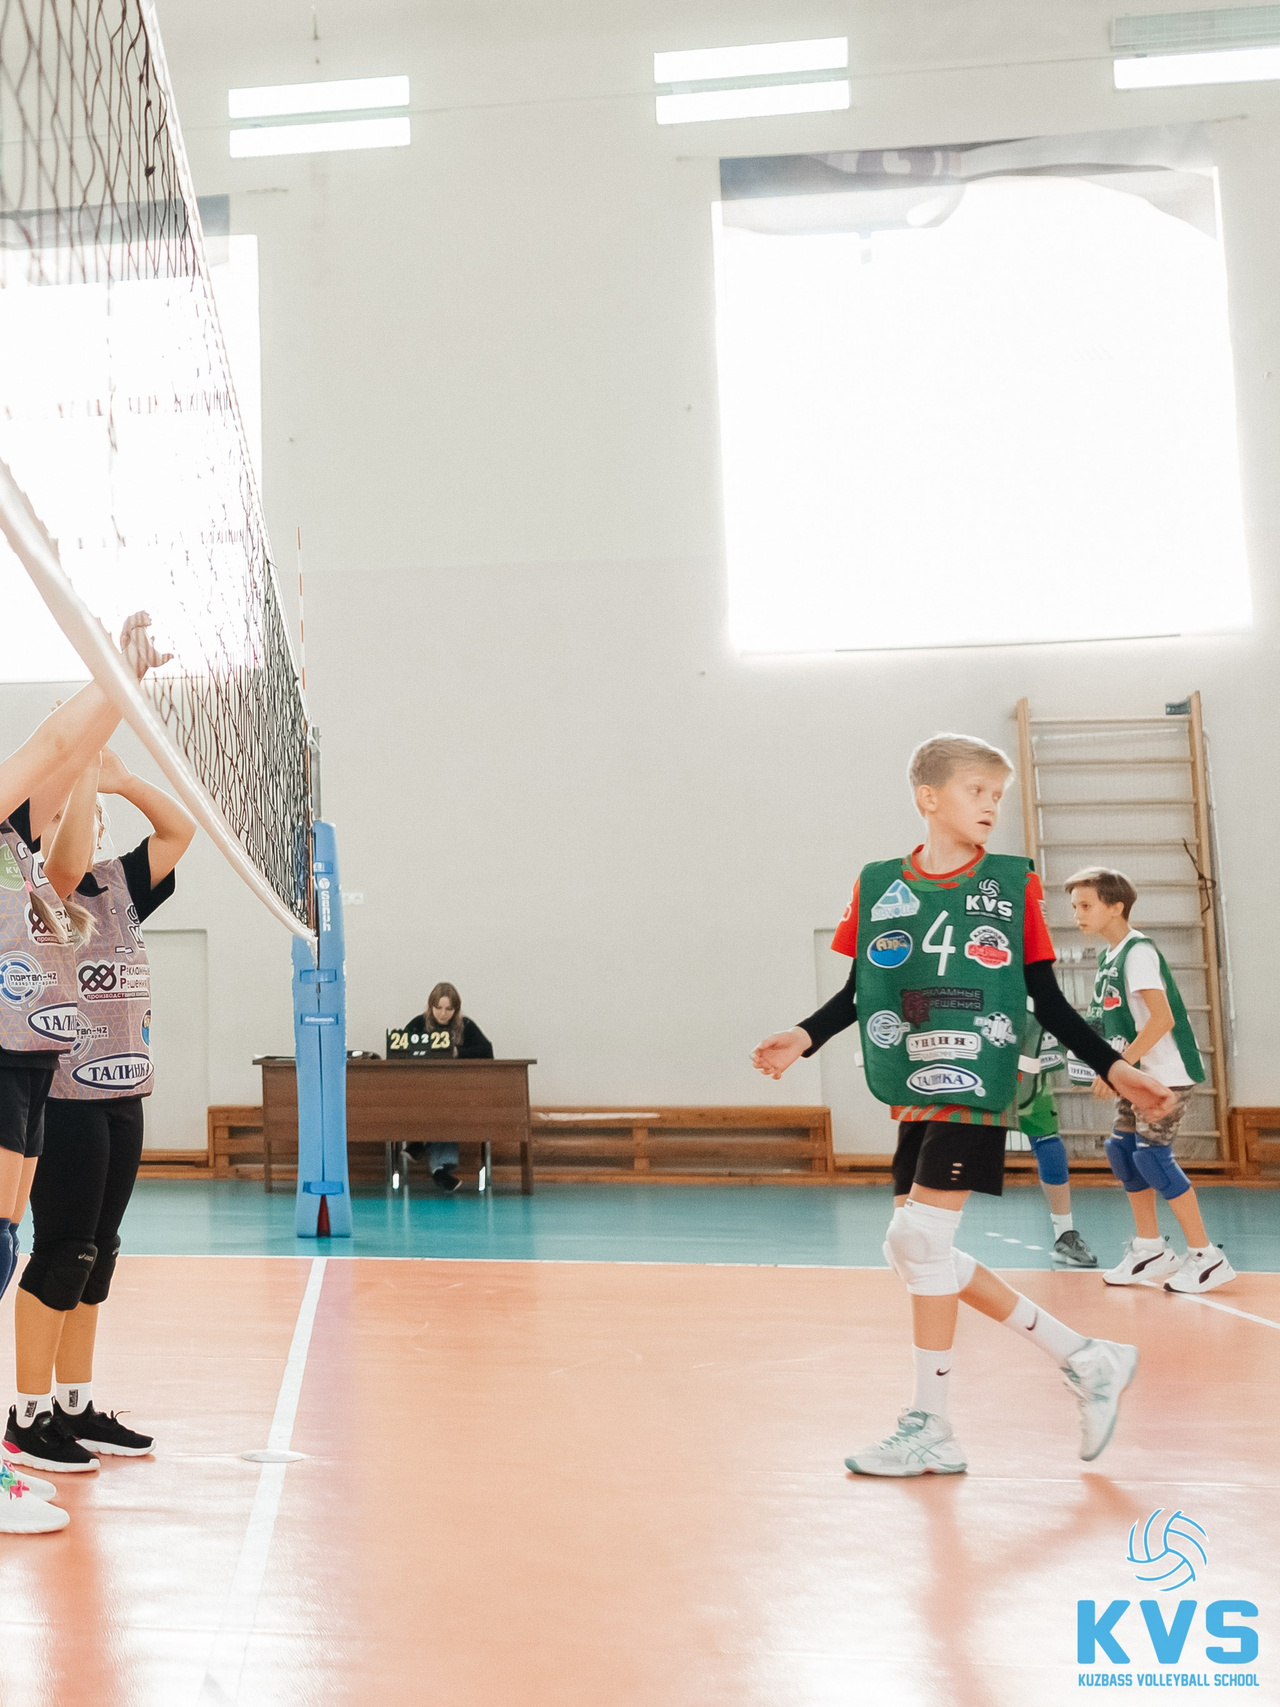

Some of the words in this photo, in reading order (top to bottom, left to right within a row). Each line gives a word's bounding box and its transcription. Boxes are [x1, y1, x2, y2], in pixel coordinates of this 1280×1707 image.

[965, 894, 1013, 917] KVS
[921, 909, 957, 977] 4
[389, 1032, 409, 1050] 24
[430, 1031, 451, 1049] 23
